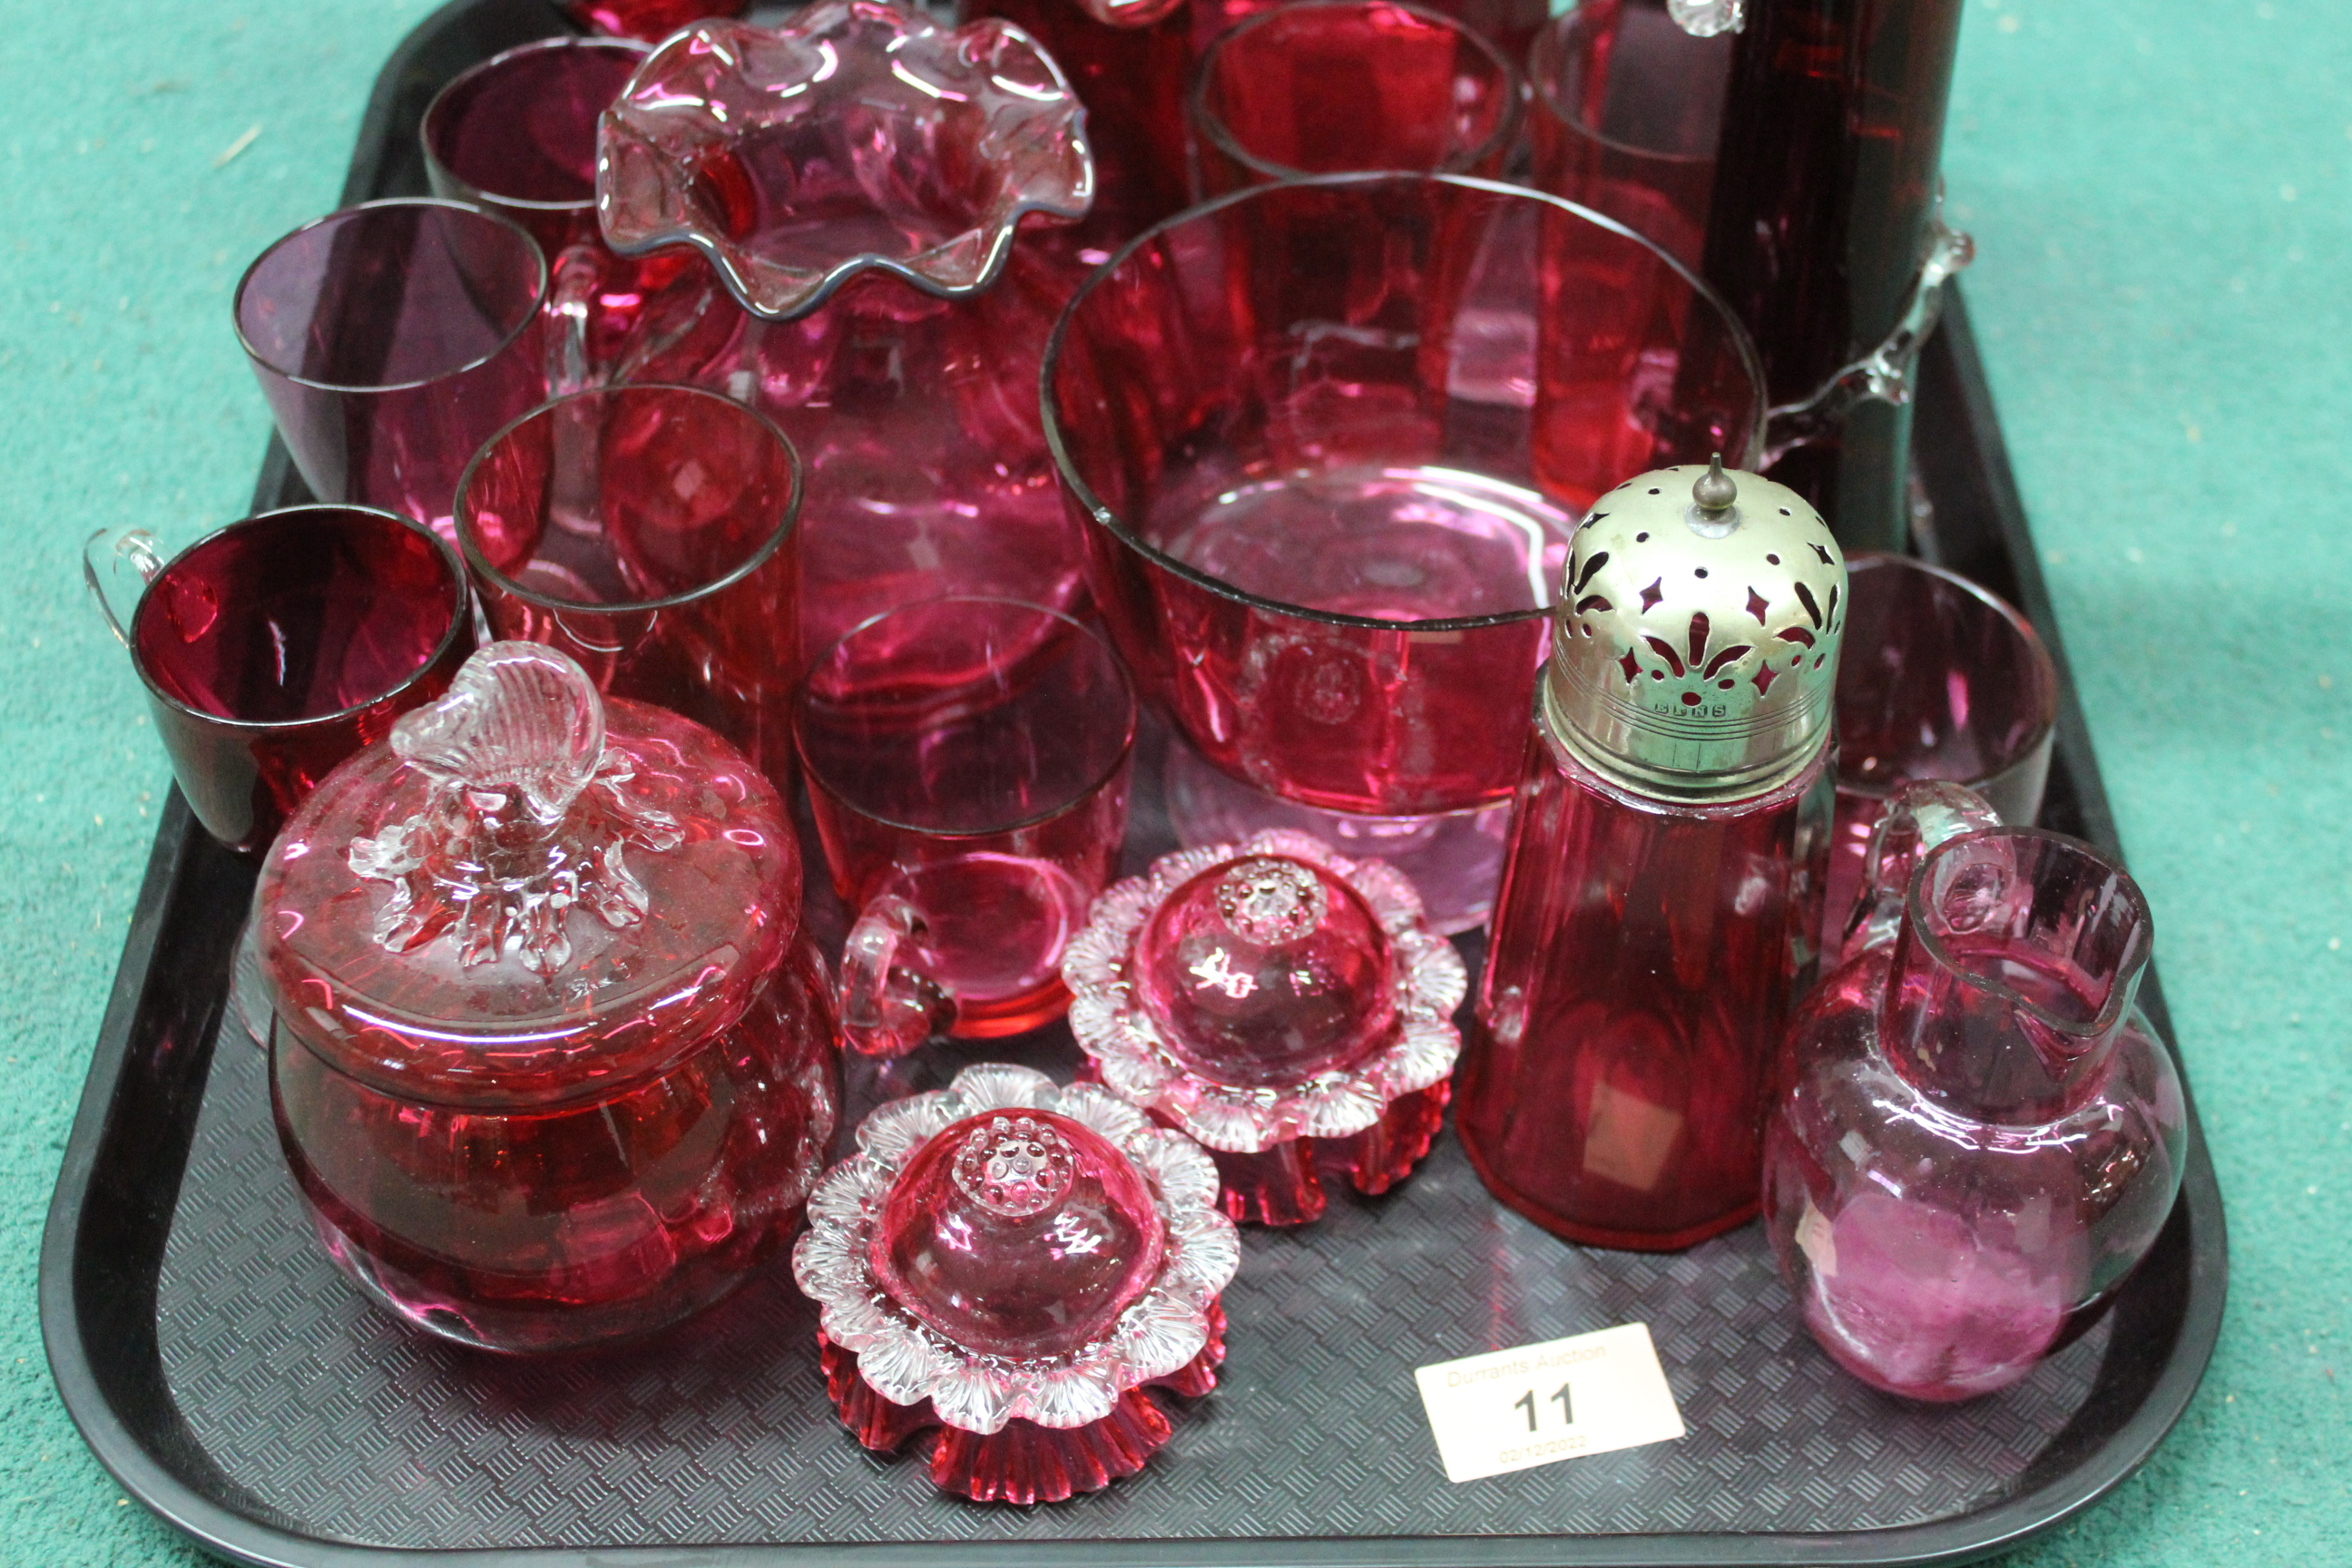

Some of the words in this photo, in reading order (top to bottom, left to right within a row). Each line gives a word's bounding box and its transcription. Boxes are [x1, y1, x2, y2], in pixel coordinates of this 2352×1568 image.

[1446, 1358, 1531, 1387] Durrants
[1535, 1345, 1607, 1370] Auction
[1514, 1382, 1574, 1433] 11
[1499, 1435, 1587, 1464] 02/12/2022
